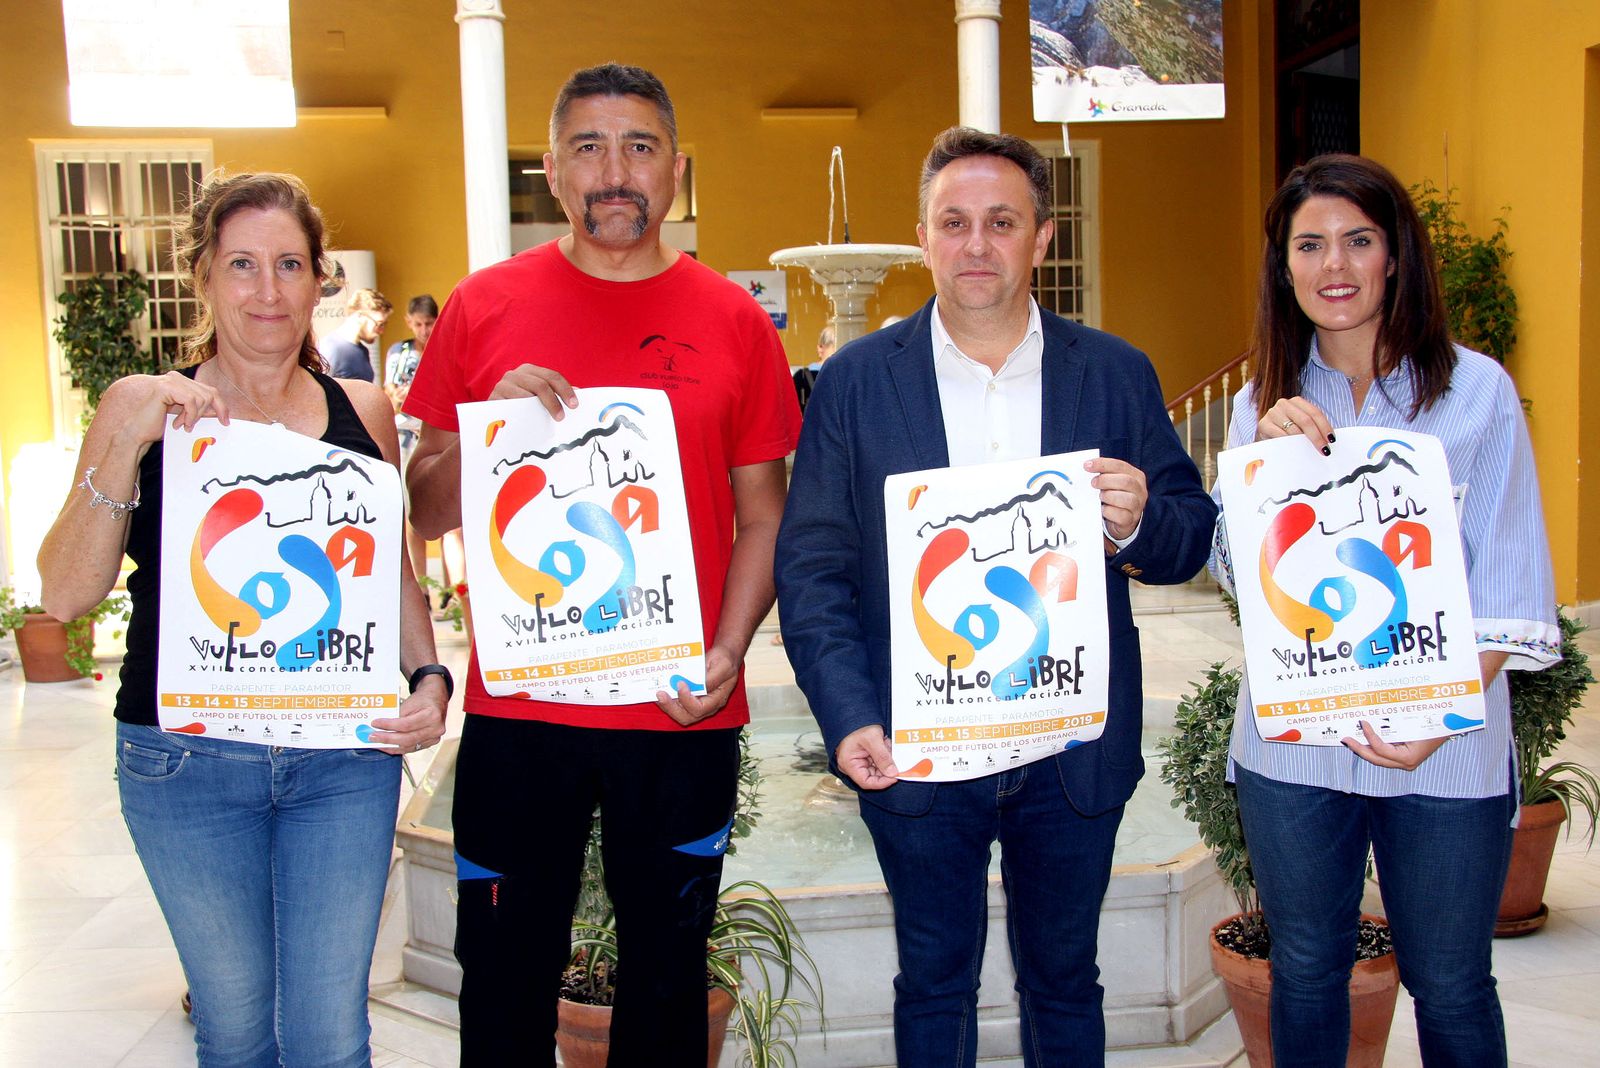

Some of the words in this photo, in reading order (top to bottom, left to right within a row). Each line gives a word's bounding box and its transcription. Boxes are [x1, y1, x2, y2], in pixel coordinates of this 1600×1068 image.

[1111, 101, 1167, 112] Granada
[502, 593, 582, 642] VUELO
[190, 622, 276, 672] VUELO
[1272, 628, 1352, 676] VUELO
[498, 672, 513, 680] 13
[524, 668, 540, 678] 14
[552, 666, 566, 674] 15
[569, 650, 656, 673] SEPTIEMBRE
[660, 646, 690, 660] 2019
[611, 670, 627, 678] LOS
[629, 663, 680, 676] VETERANOS
[285, 684, 351, 692] PARAMOTOR
[915, 654, 991, 704] VUELO
[176, 696, 191, 706] 13
[204, 697, 220, 707] 14
[234, 697, 248, 708] 15
[253, 696, 346, 708] SEPTIEMBRE
[351, 696, 384, 707] 2019
[1270, 705, 1284, 715] 13
[1296, 703, 1310, 712] 14
[1322, 700, 1336, 709] 15
[1340, 688, 1428, 707] SEPTIEMBRE
[1432, 684, 1466, 698] 2019
[192, 712, 225, 720] CAMPO
[228, 712, 240, 720] DE
[316, 712, 368, 720] VETERANOS
[1286, 716, 1317, 725] CAMPO
[1319, 714, 1330, 722] DE
[1368, 708, 1380, 716] DE
[1382, 706, 1398, 714] LOS
[1400, 702, 1454, 713] VETERANOS
[906, 732, 920, 742] 13
[930, 730, 944, 740] 14
[956, 729, 970, 739] 15
[974, 720, 1059, 738] SEPTIEMBRE
[1063, 716, 1092, 727] 2019
[920, 746, 950, 754] CAMPO
[952, 744, 964, 752] DE
[1000, 740, 1012, 748] DE
[1014, 738, 1030, 746] LOS
[1032, 730, 1078, 744] VETERANOS
